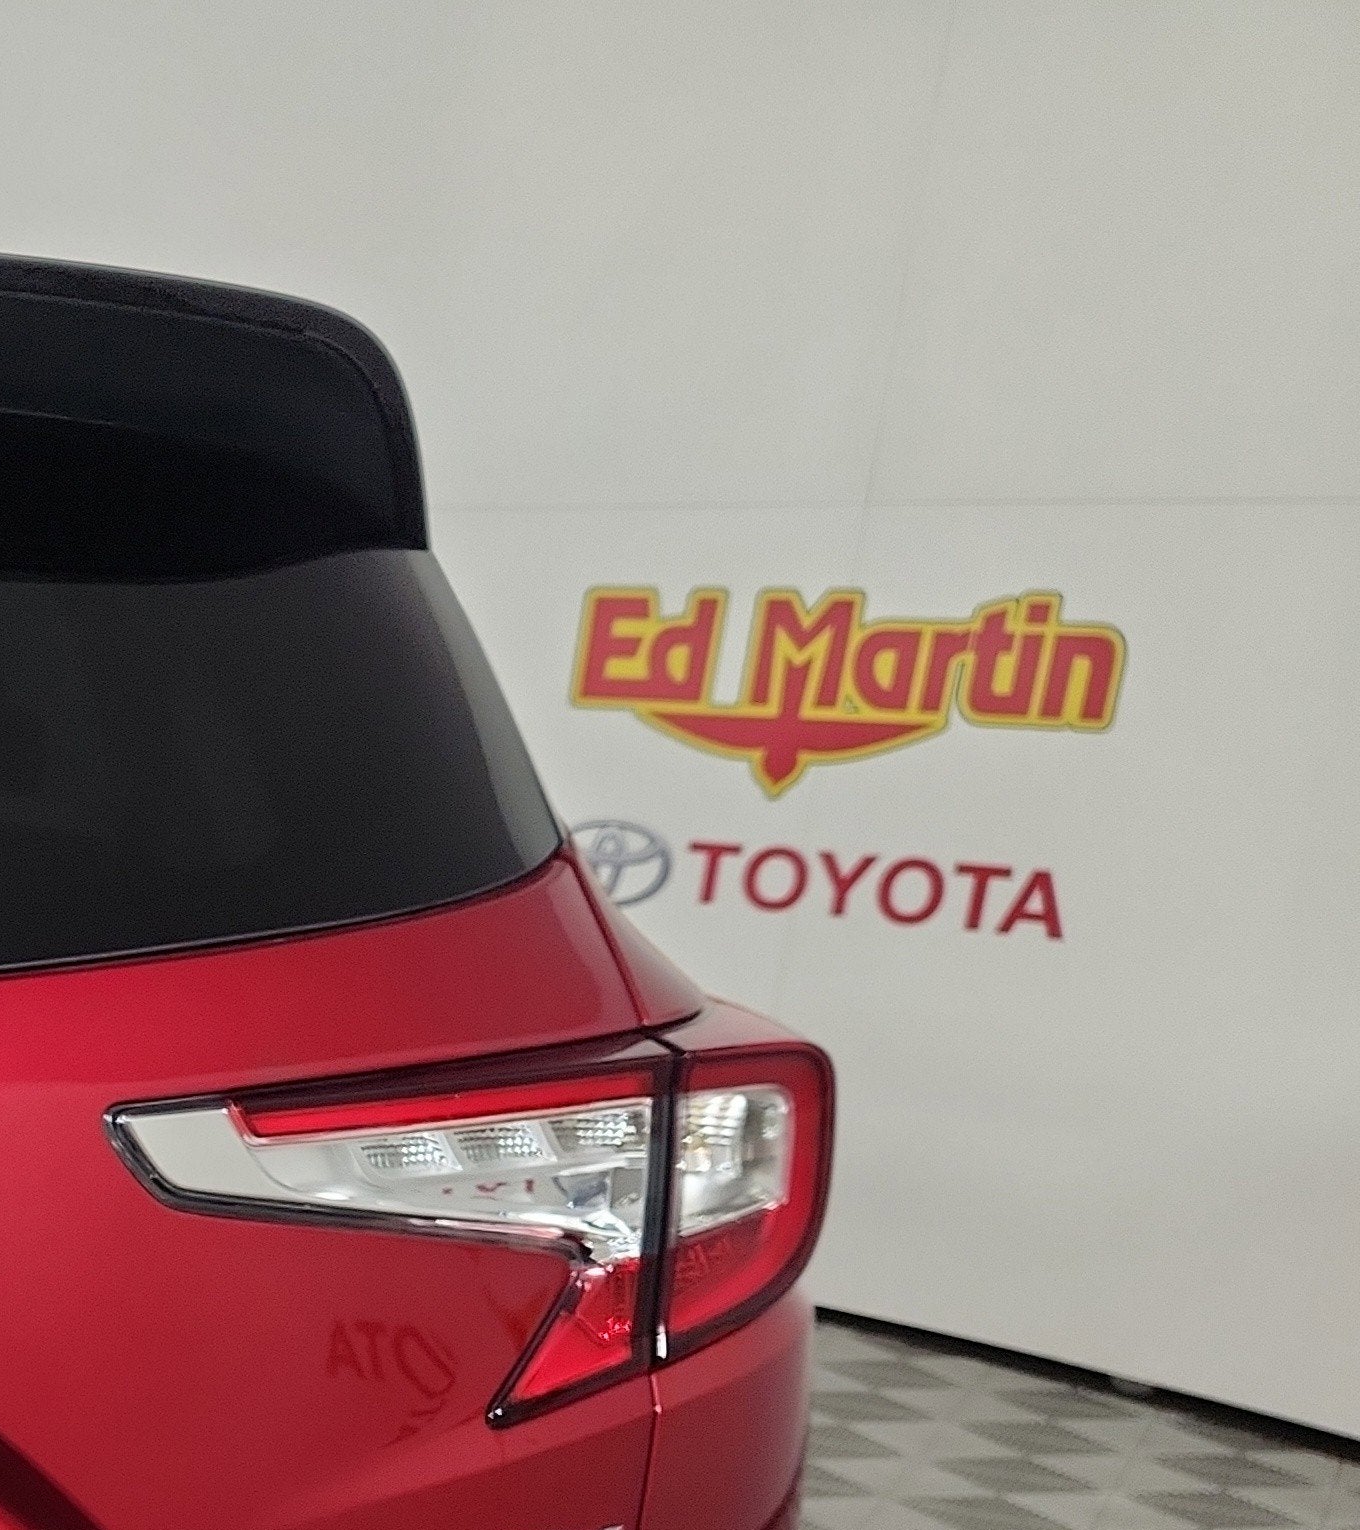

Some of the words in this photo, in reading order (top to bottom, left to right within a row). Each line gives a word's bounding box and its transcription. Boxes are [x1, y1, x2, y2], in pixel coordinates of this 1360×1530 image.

[571, 587, 729, 708] Ed
[738, 588, 1126, 733] Martin
[688, 841, 1063, 940] TOYOTA
